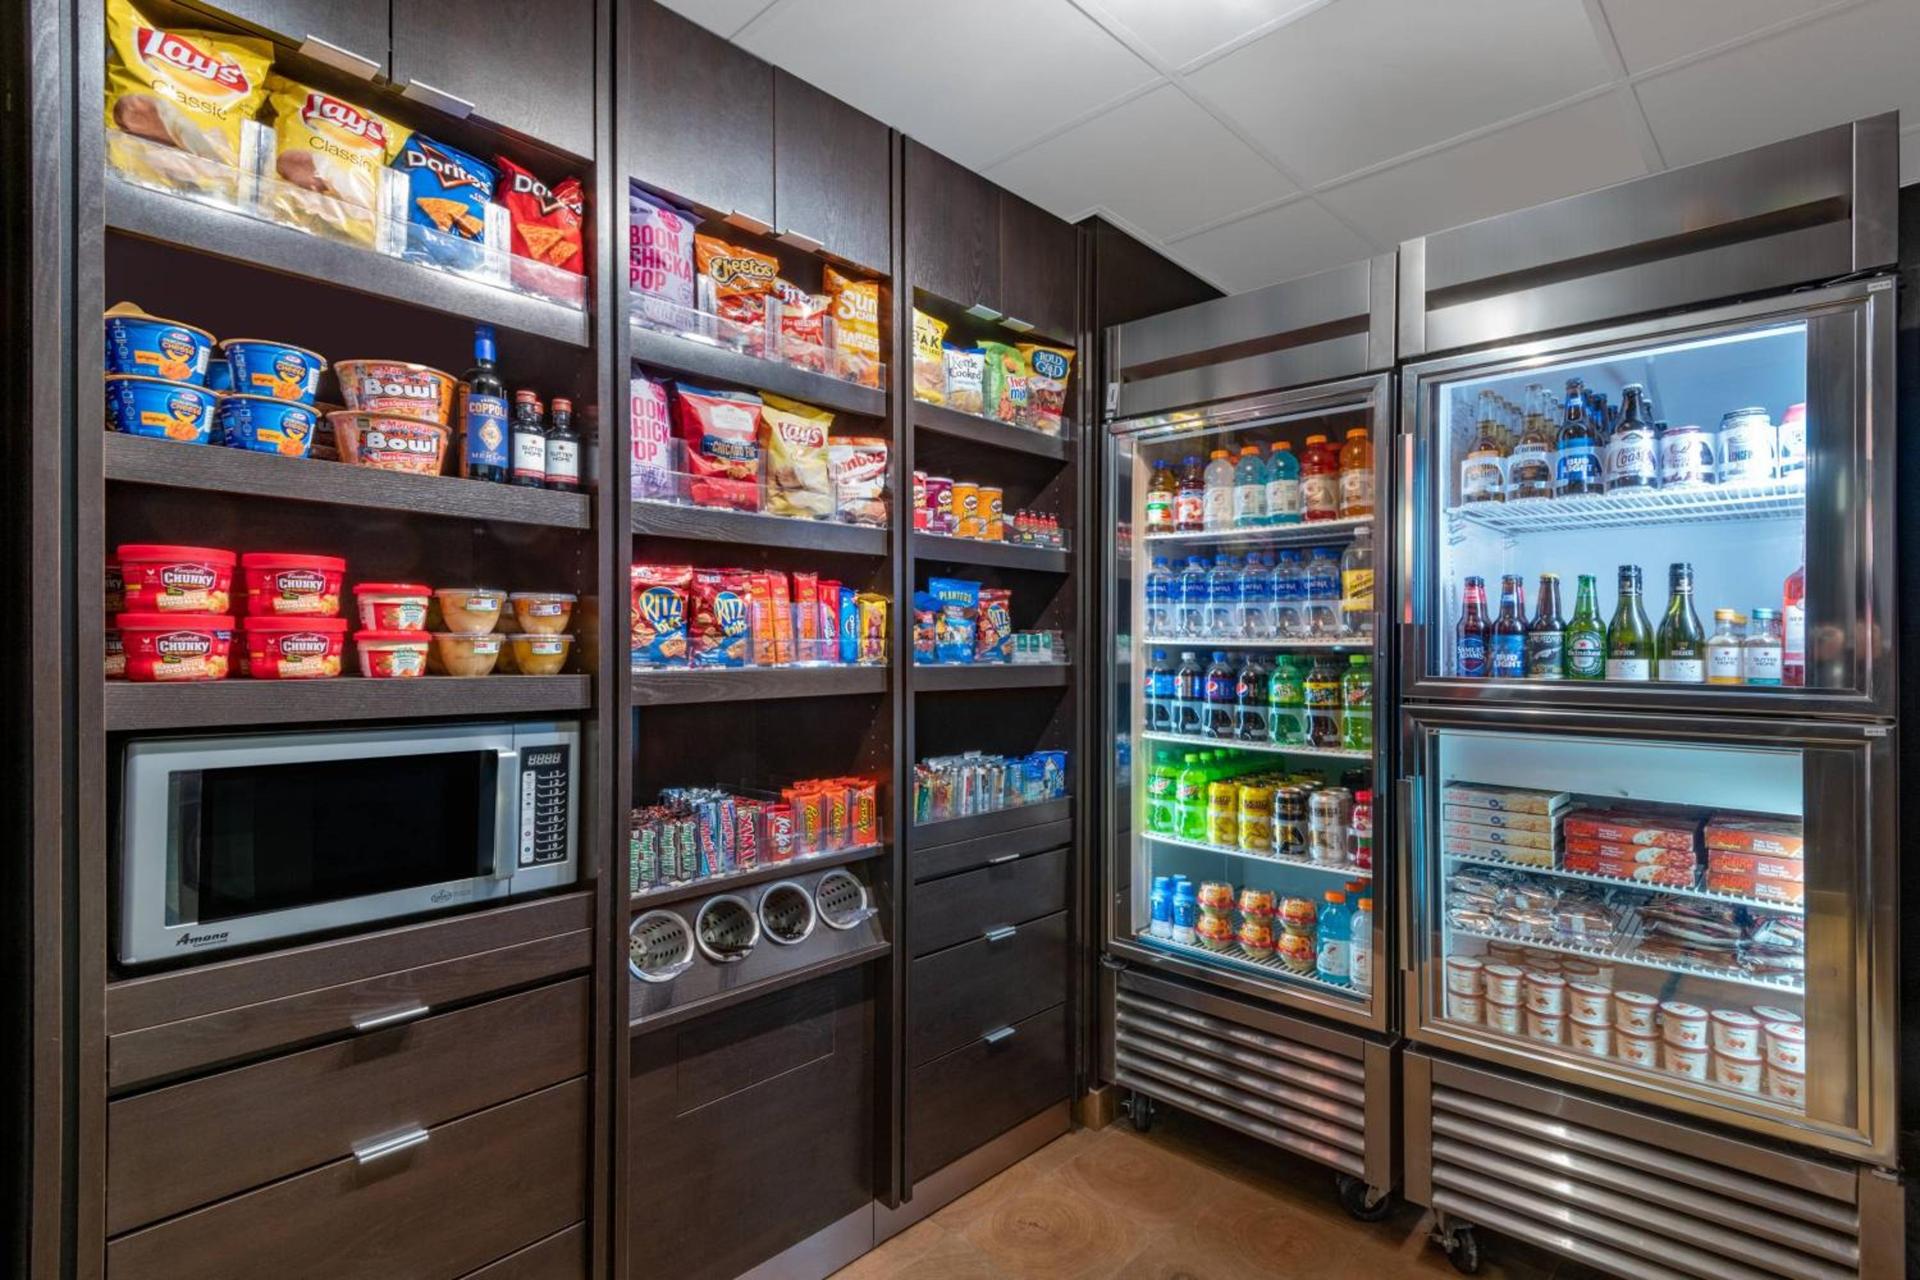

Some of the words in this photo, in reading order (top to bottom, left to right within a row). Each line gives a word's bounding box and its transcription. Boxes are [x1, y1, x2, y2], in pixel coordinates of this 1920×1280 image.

[144, 30, 241, 84] Lay's
[307, 94, 384, 142] Lay's
[407, 150, 491, 196] Doritos
[629, 225, 680, 252] BOOM
[710, 257, 775, 281] Cheetos
[629, 269, 667, 292] POP
[363, 378, 438, 400] Bowl
[366, 431, 437, 453] Bowl
[840, 450, 886, 470] mbos
[163, 572, 213, 588] CHUNKY
[278, 578, 324, 593] CHUNKY
[640, 588, 683, 621] RITZ
[714, 592, 746, 625] RITZ
[159, 640, 210, 655] CHUNKY
[282, 640, 327, 655] CHUNKY
[175, 931, 230, 946] Amana
